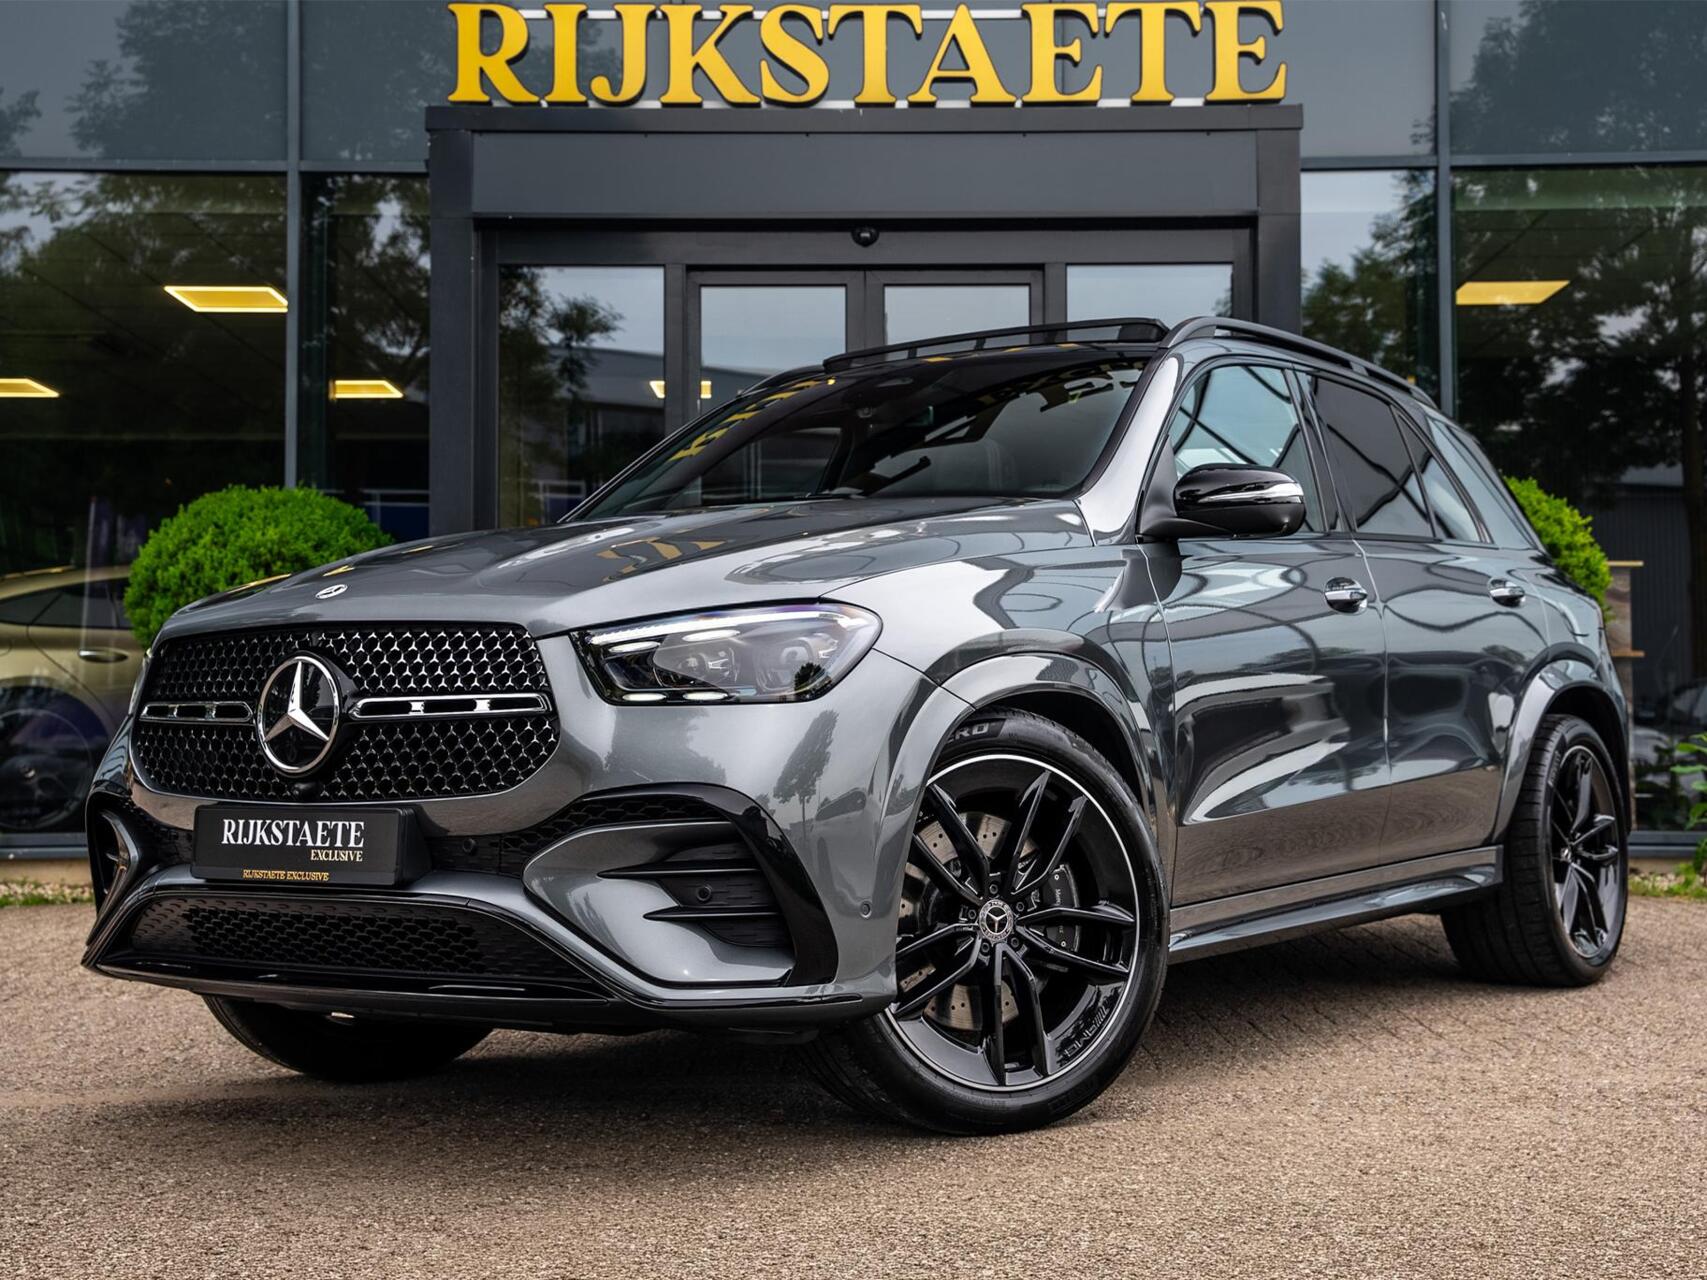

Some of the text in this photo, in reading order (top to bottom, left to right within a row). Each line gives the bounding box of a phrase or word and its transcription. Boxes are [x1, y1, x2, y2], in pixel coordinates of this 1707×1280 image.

[447, 1, 1287, 106] RIJKSTAETE
[221, 818, 365, 848] RIJKSTAETE
[310, 849, 363, 862] EXCLUSIVE
[242, 869, 329, 881] RIJKSTAETE EXCLUSIVE
